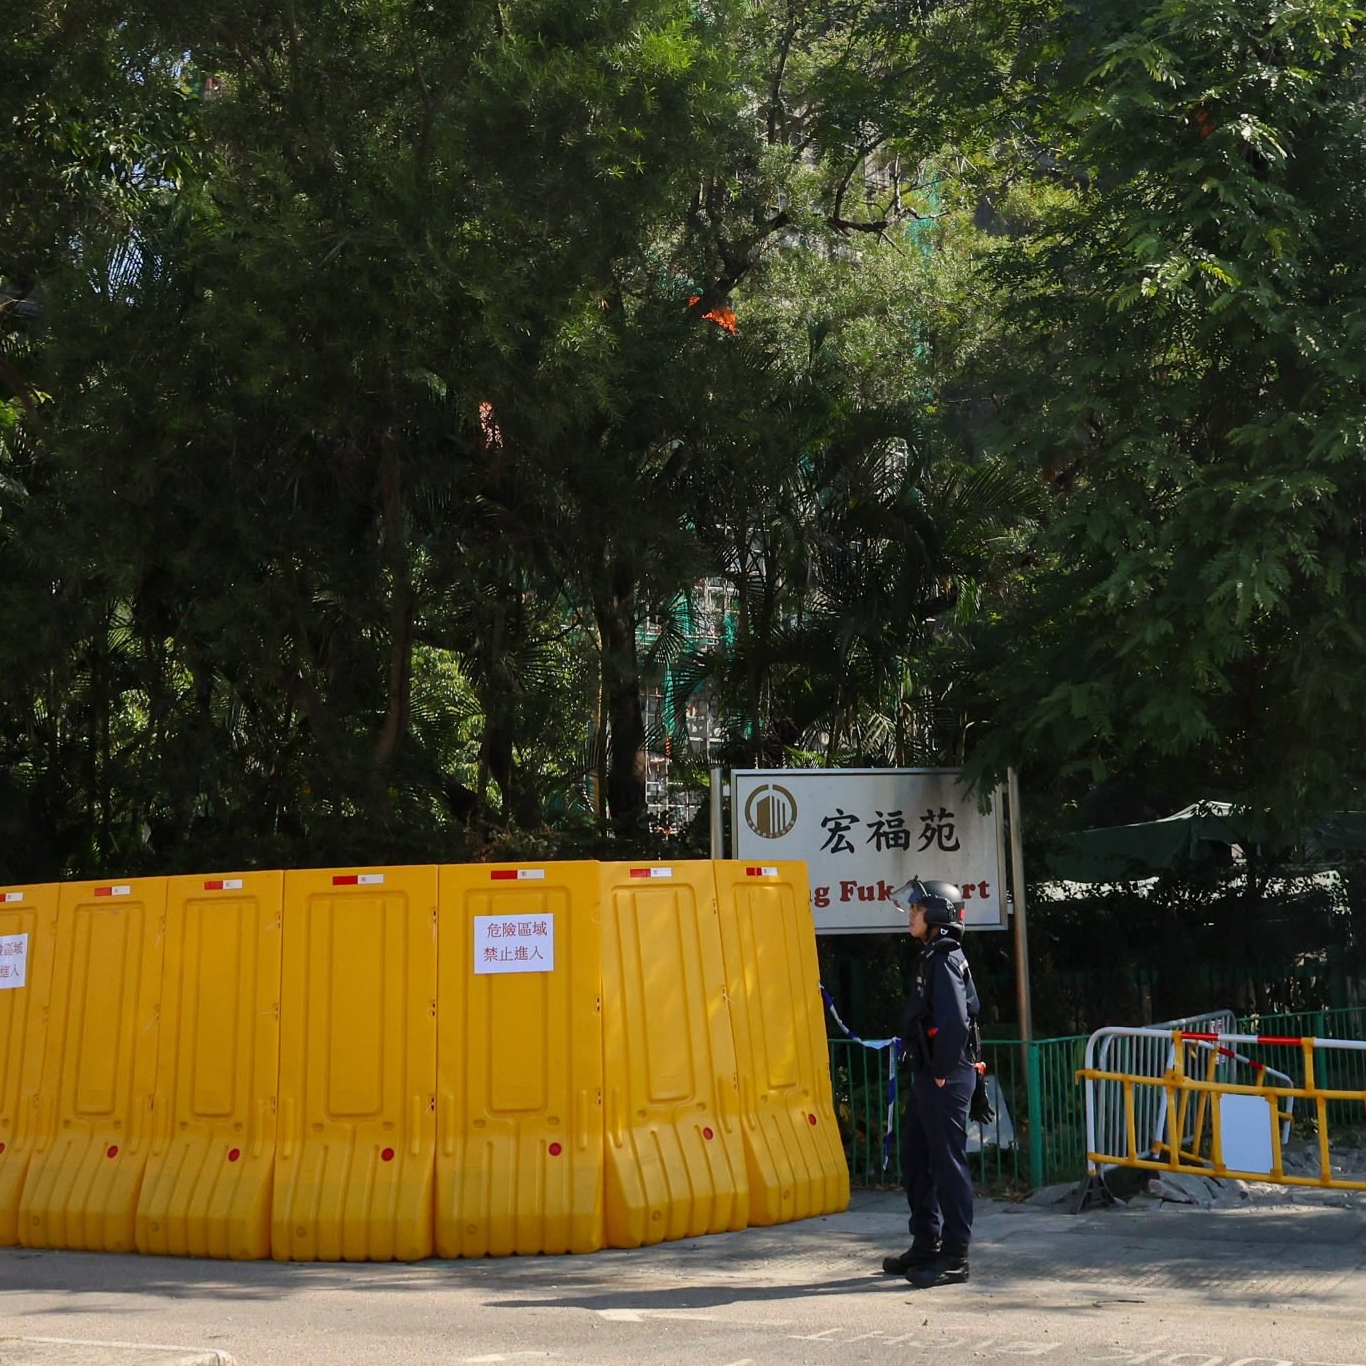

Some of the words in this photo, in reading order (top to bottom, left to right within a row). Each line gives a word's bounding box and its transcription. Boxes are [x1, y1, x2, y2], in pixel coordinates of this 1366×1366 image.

[820, 808, 960, 854] 宏福苑
[487, 921, 547, 938] 危險區域
[483, 945, 544, 962] 禁止進入
